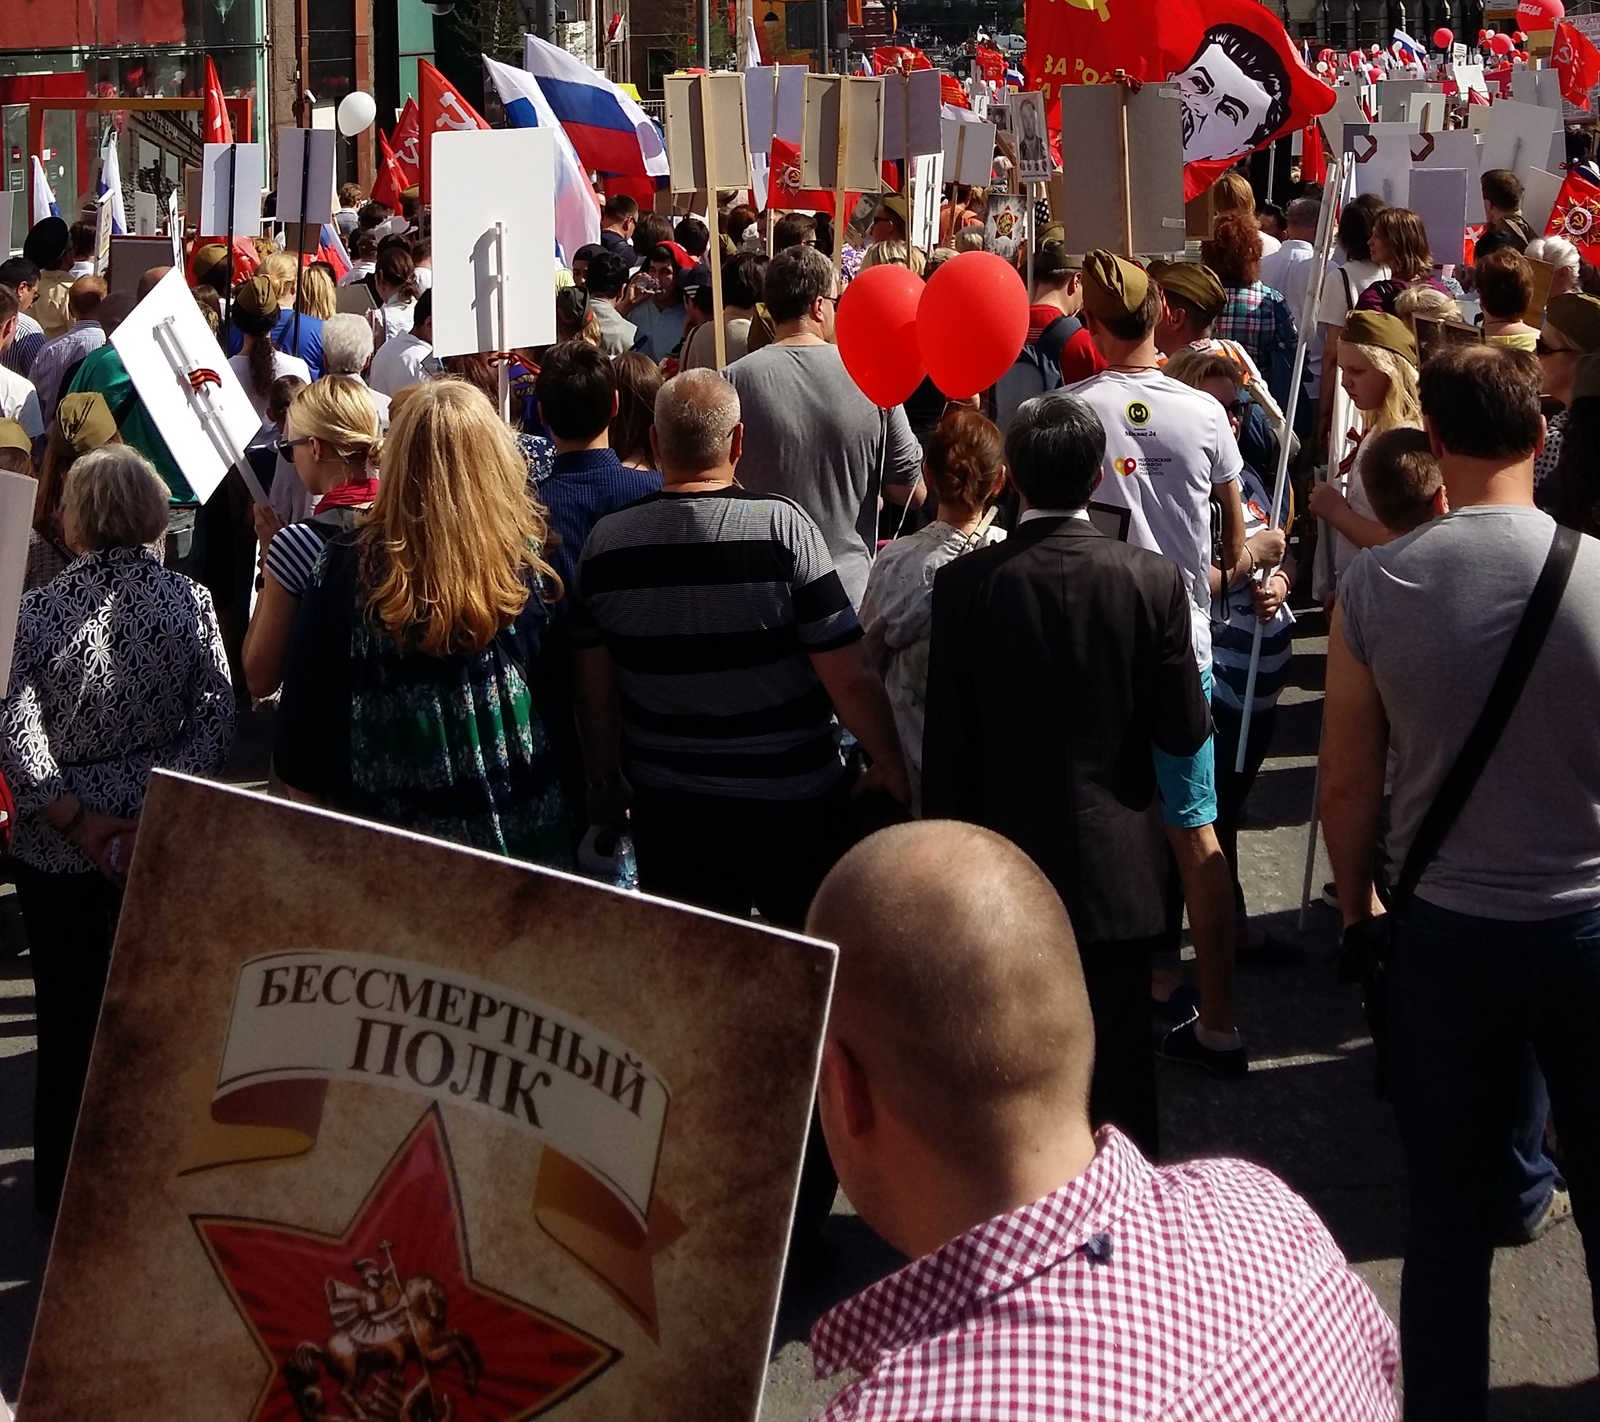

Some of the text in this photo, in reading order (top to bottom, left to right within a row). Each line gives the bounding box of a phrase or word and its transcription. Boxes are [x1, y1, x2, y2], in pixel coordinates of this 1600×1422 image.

[1044, 54, 1067, 76] ЗА
[257, 964, 650, 1119] БЕССМЕРТНЫЙ
[347, 1016, 553, 1129] ПОЛК
